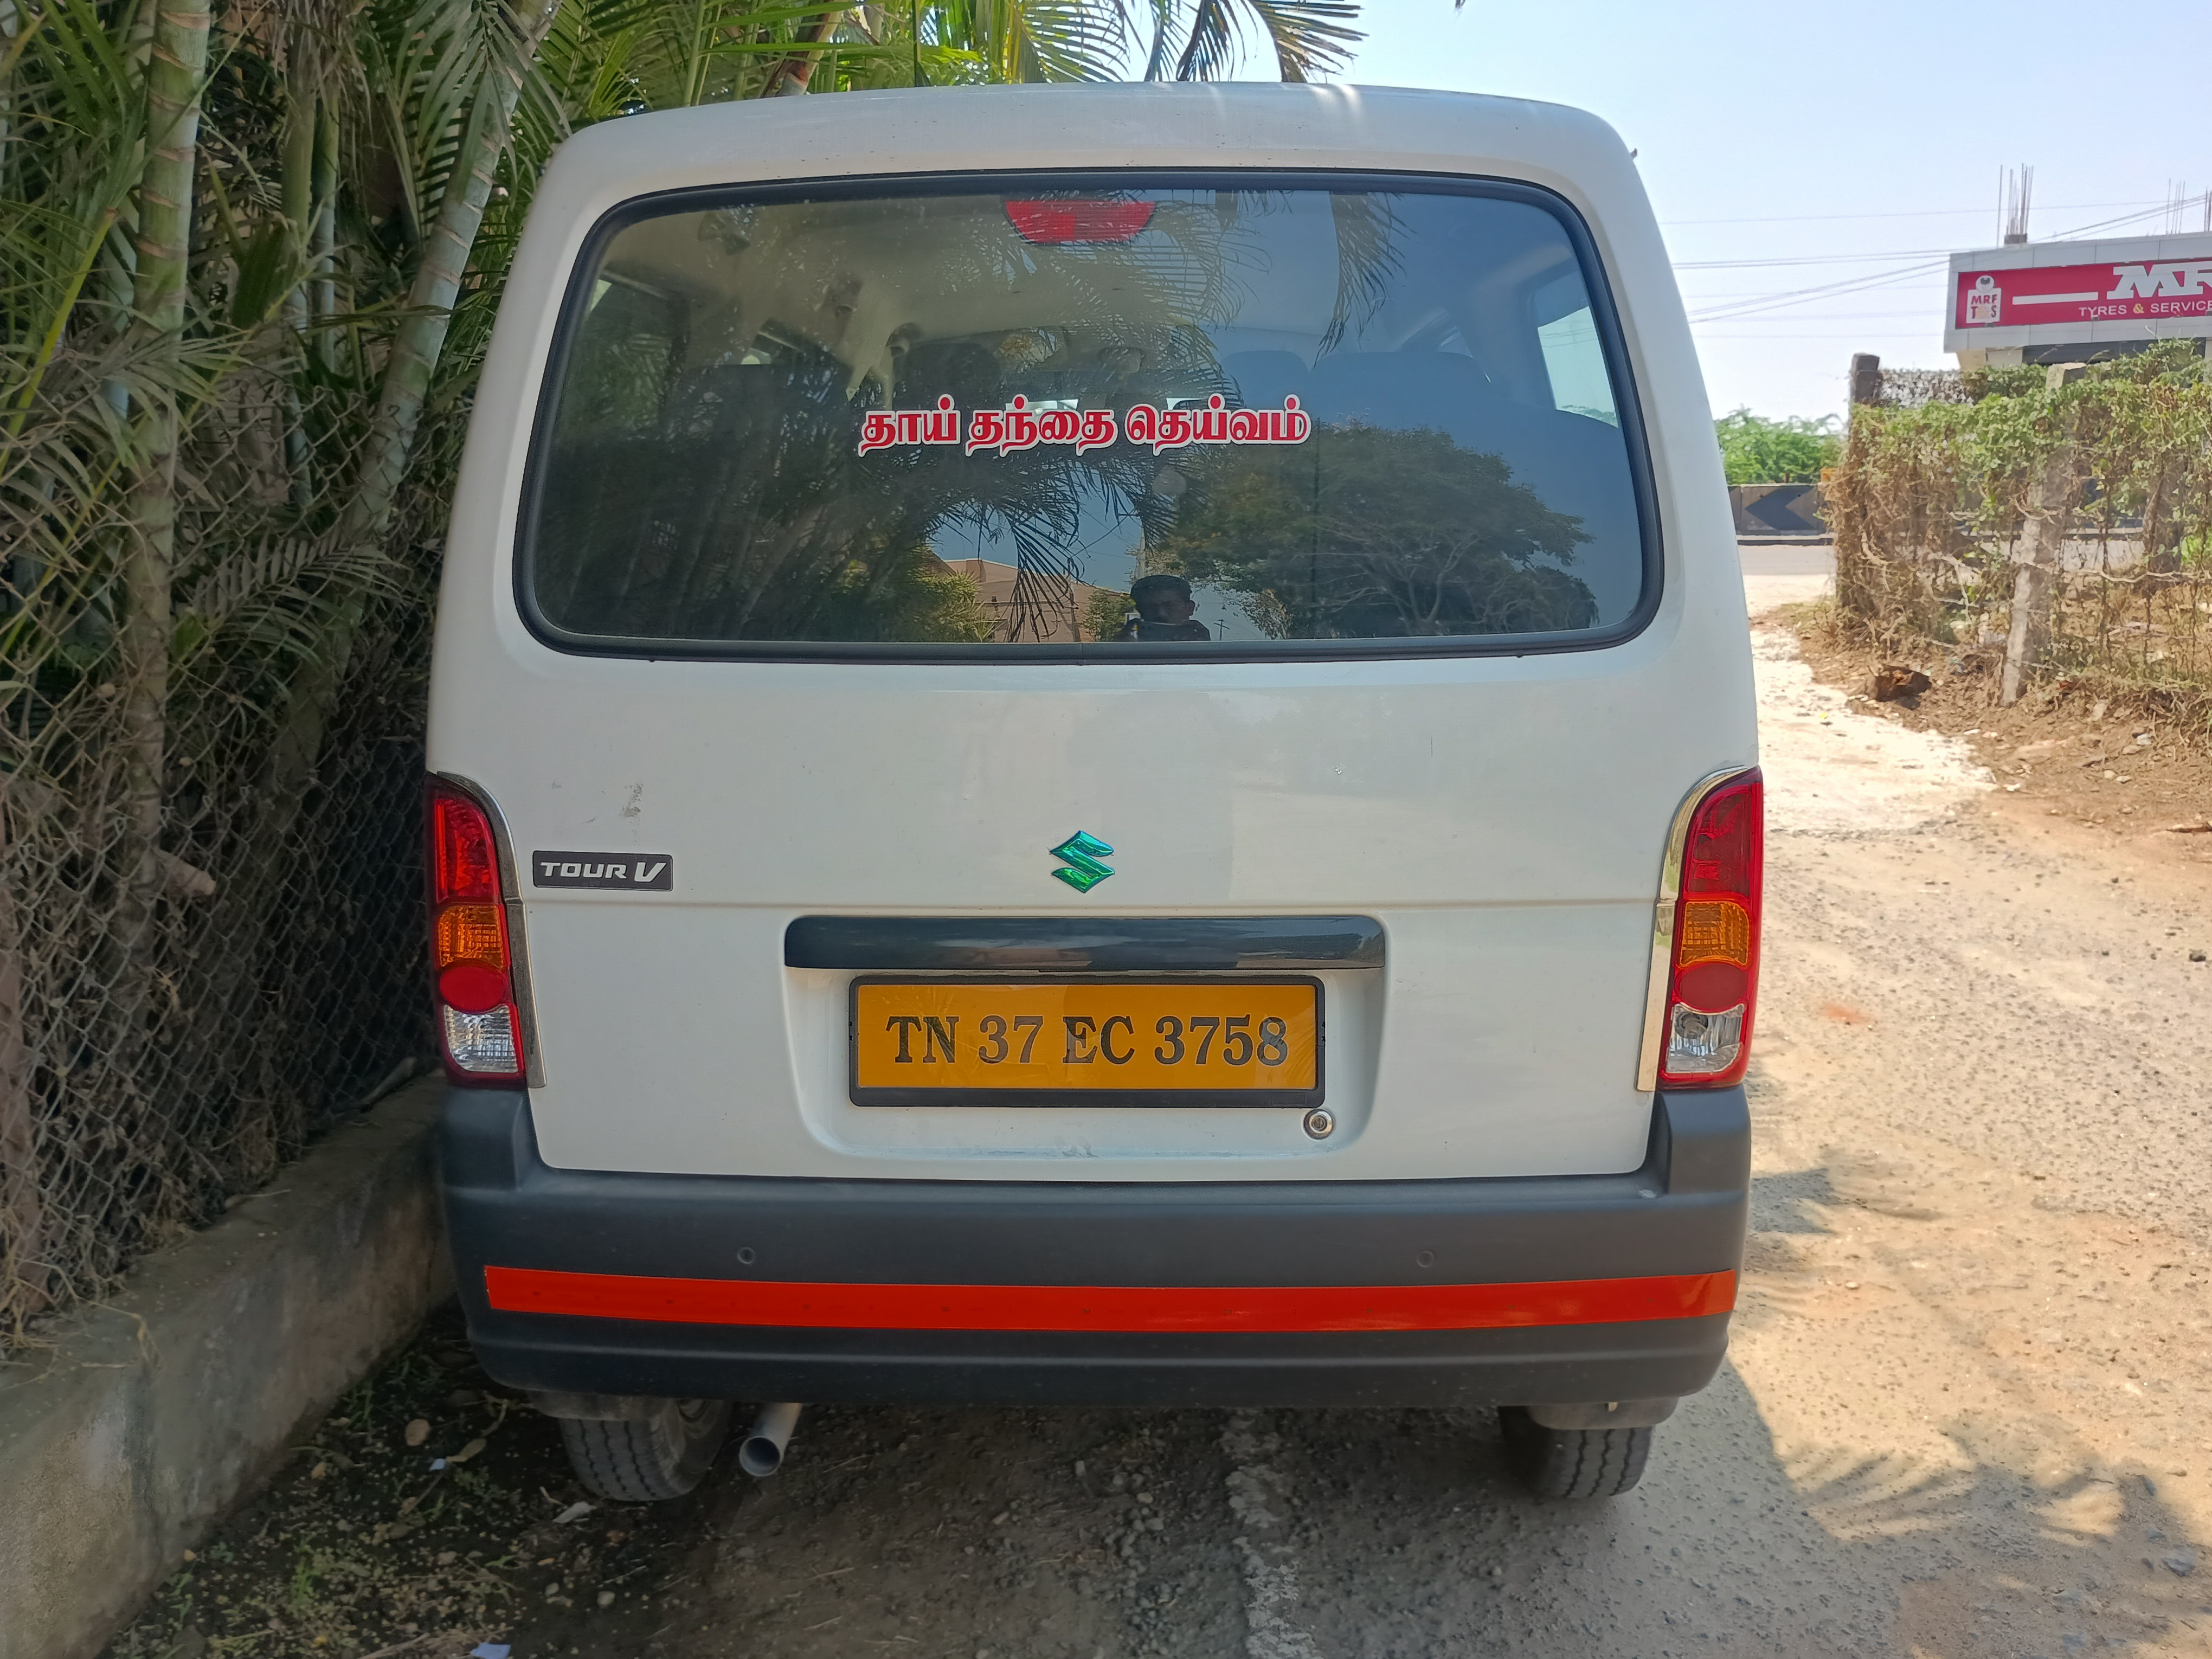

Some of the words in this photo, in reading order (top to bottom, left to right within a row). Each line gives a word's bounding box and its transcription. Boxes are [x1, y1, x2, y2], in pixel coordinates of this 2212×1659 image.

[1971, 294, 1997, 304] MRF
[2079, 305, 2127, 317] TYRES
[2133, 303, 2145, 314] &
[858, 394, 962, 457] தாய்
[965, 394, 1117, 457] தந்தை
[1124, 393, 1311, 457] தெய்வம்
[541, 862, 627, 879] TOUR
[634, 861, 667, 882] V
[885, 1015, 959, 1063] TN
[978, 1015, 1044, 1064] 37
[1062, 1015, 1135, 1065] EC
[1154, 1014, 1289, 1066] 3758
